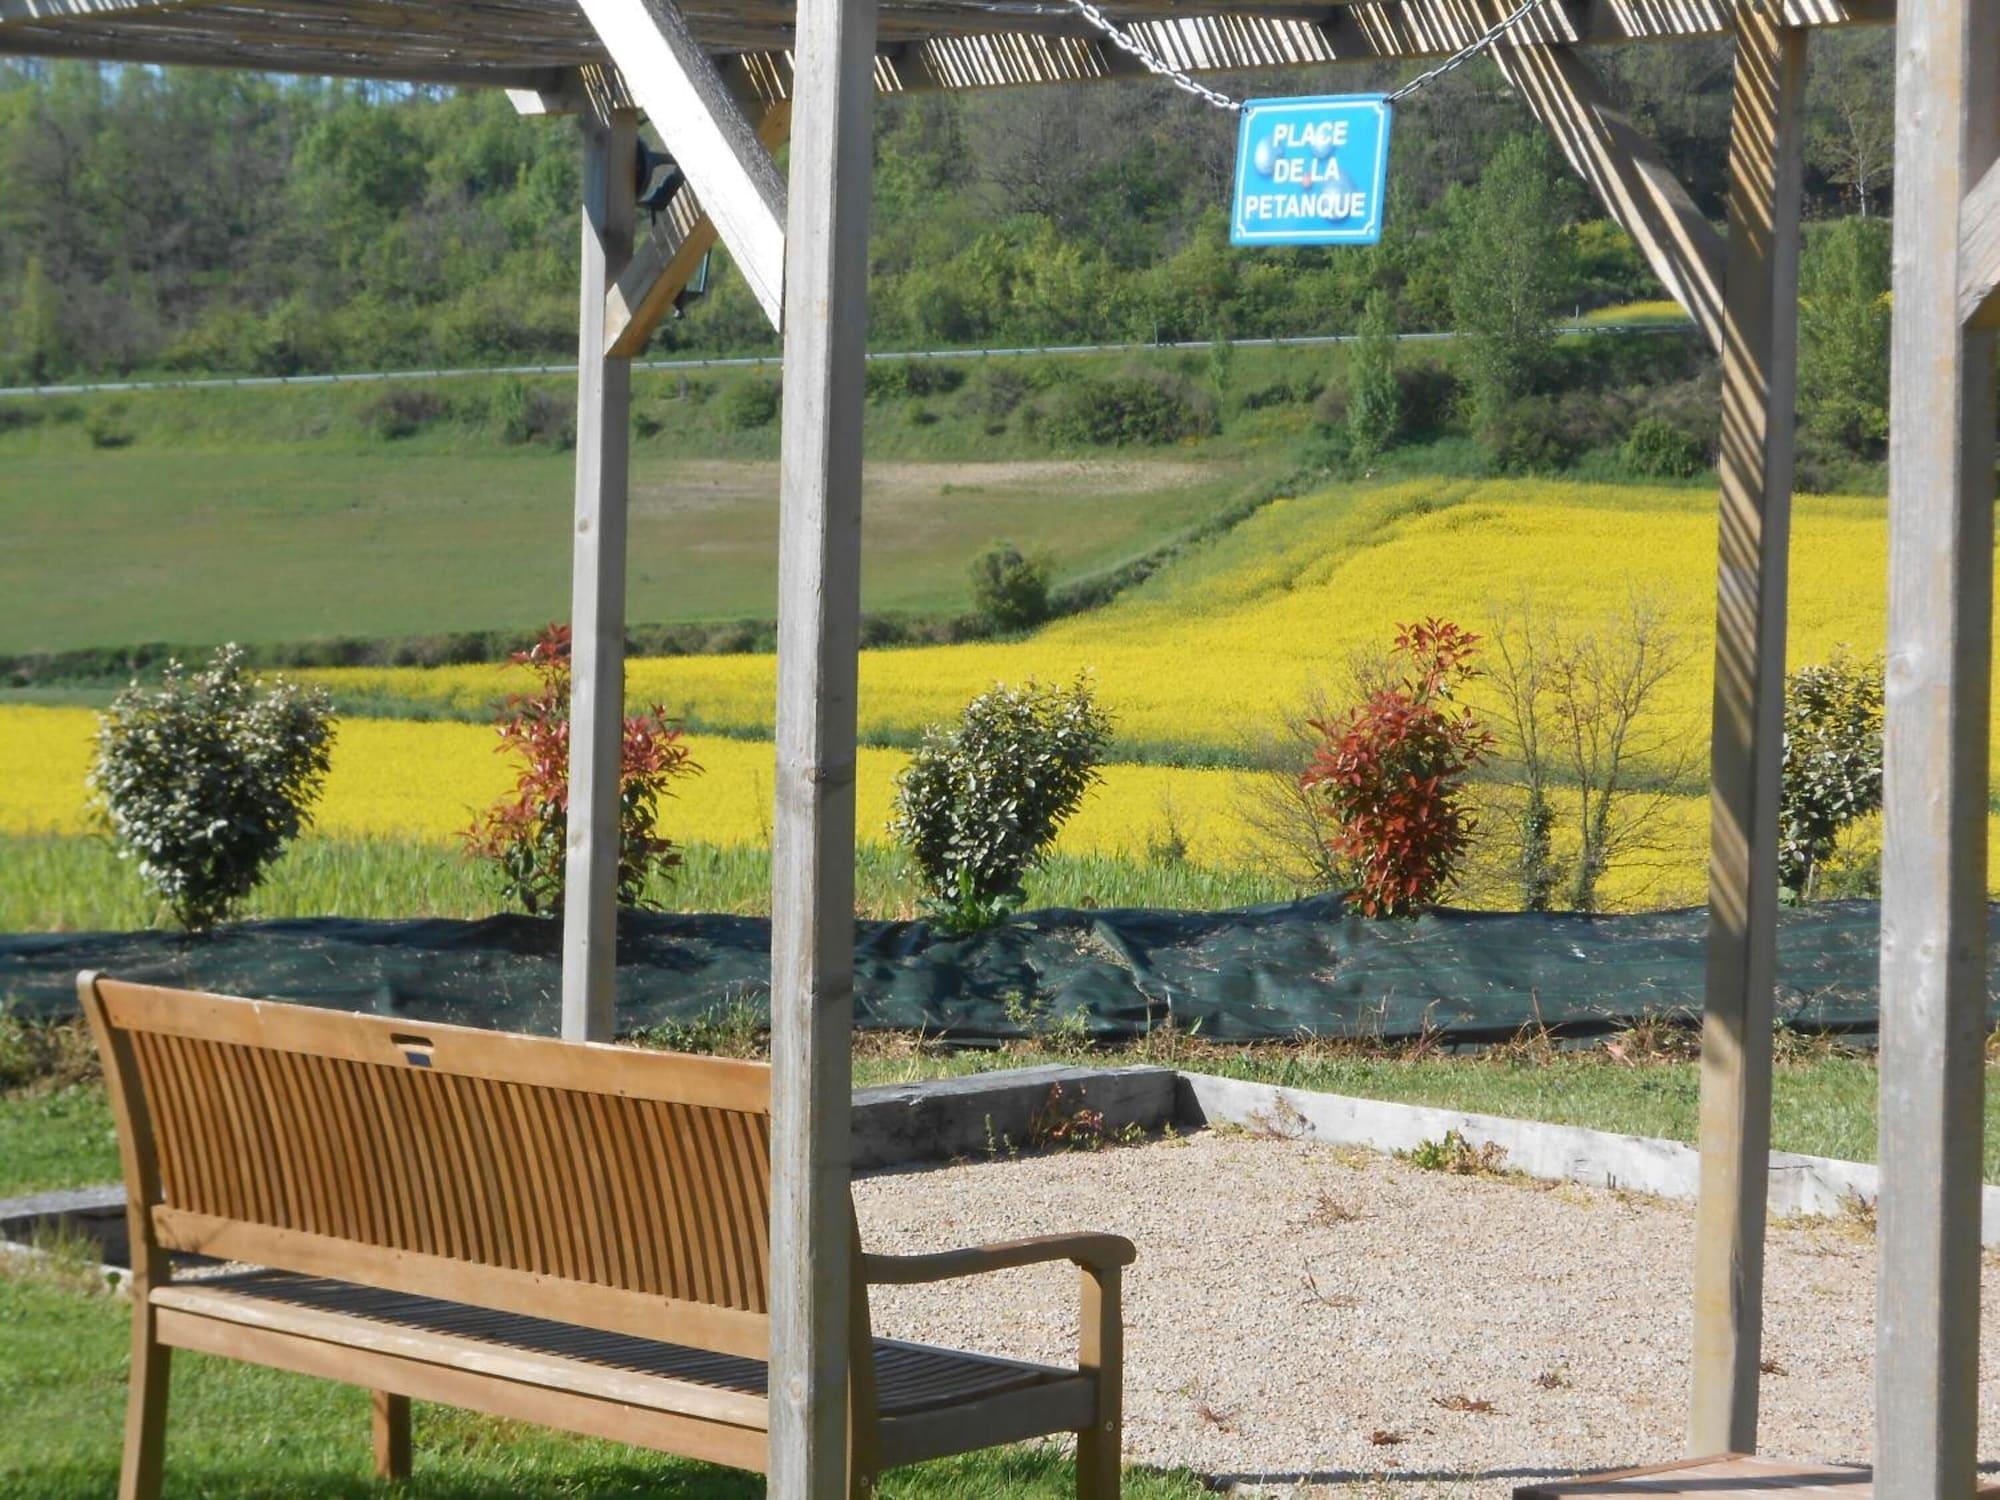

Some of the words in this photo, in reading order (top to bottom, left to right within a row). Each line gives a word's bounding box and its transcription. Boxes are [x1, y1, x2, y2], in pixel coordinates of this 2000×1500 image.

[1273, 120, 1348, 147] PLACE
[1273, 157, 1304, 183] DE
[1311, 157, 1340, 182] LA
[1245, 192, 1366, 219] PETANQUE
